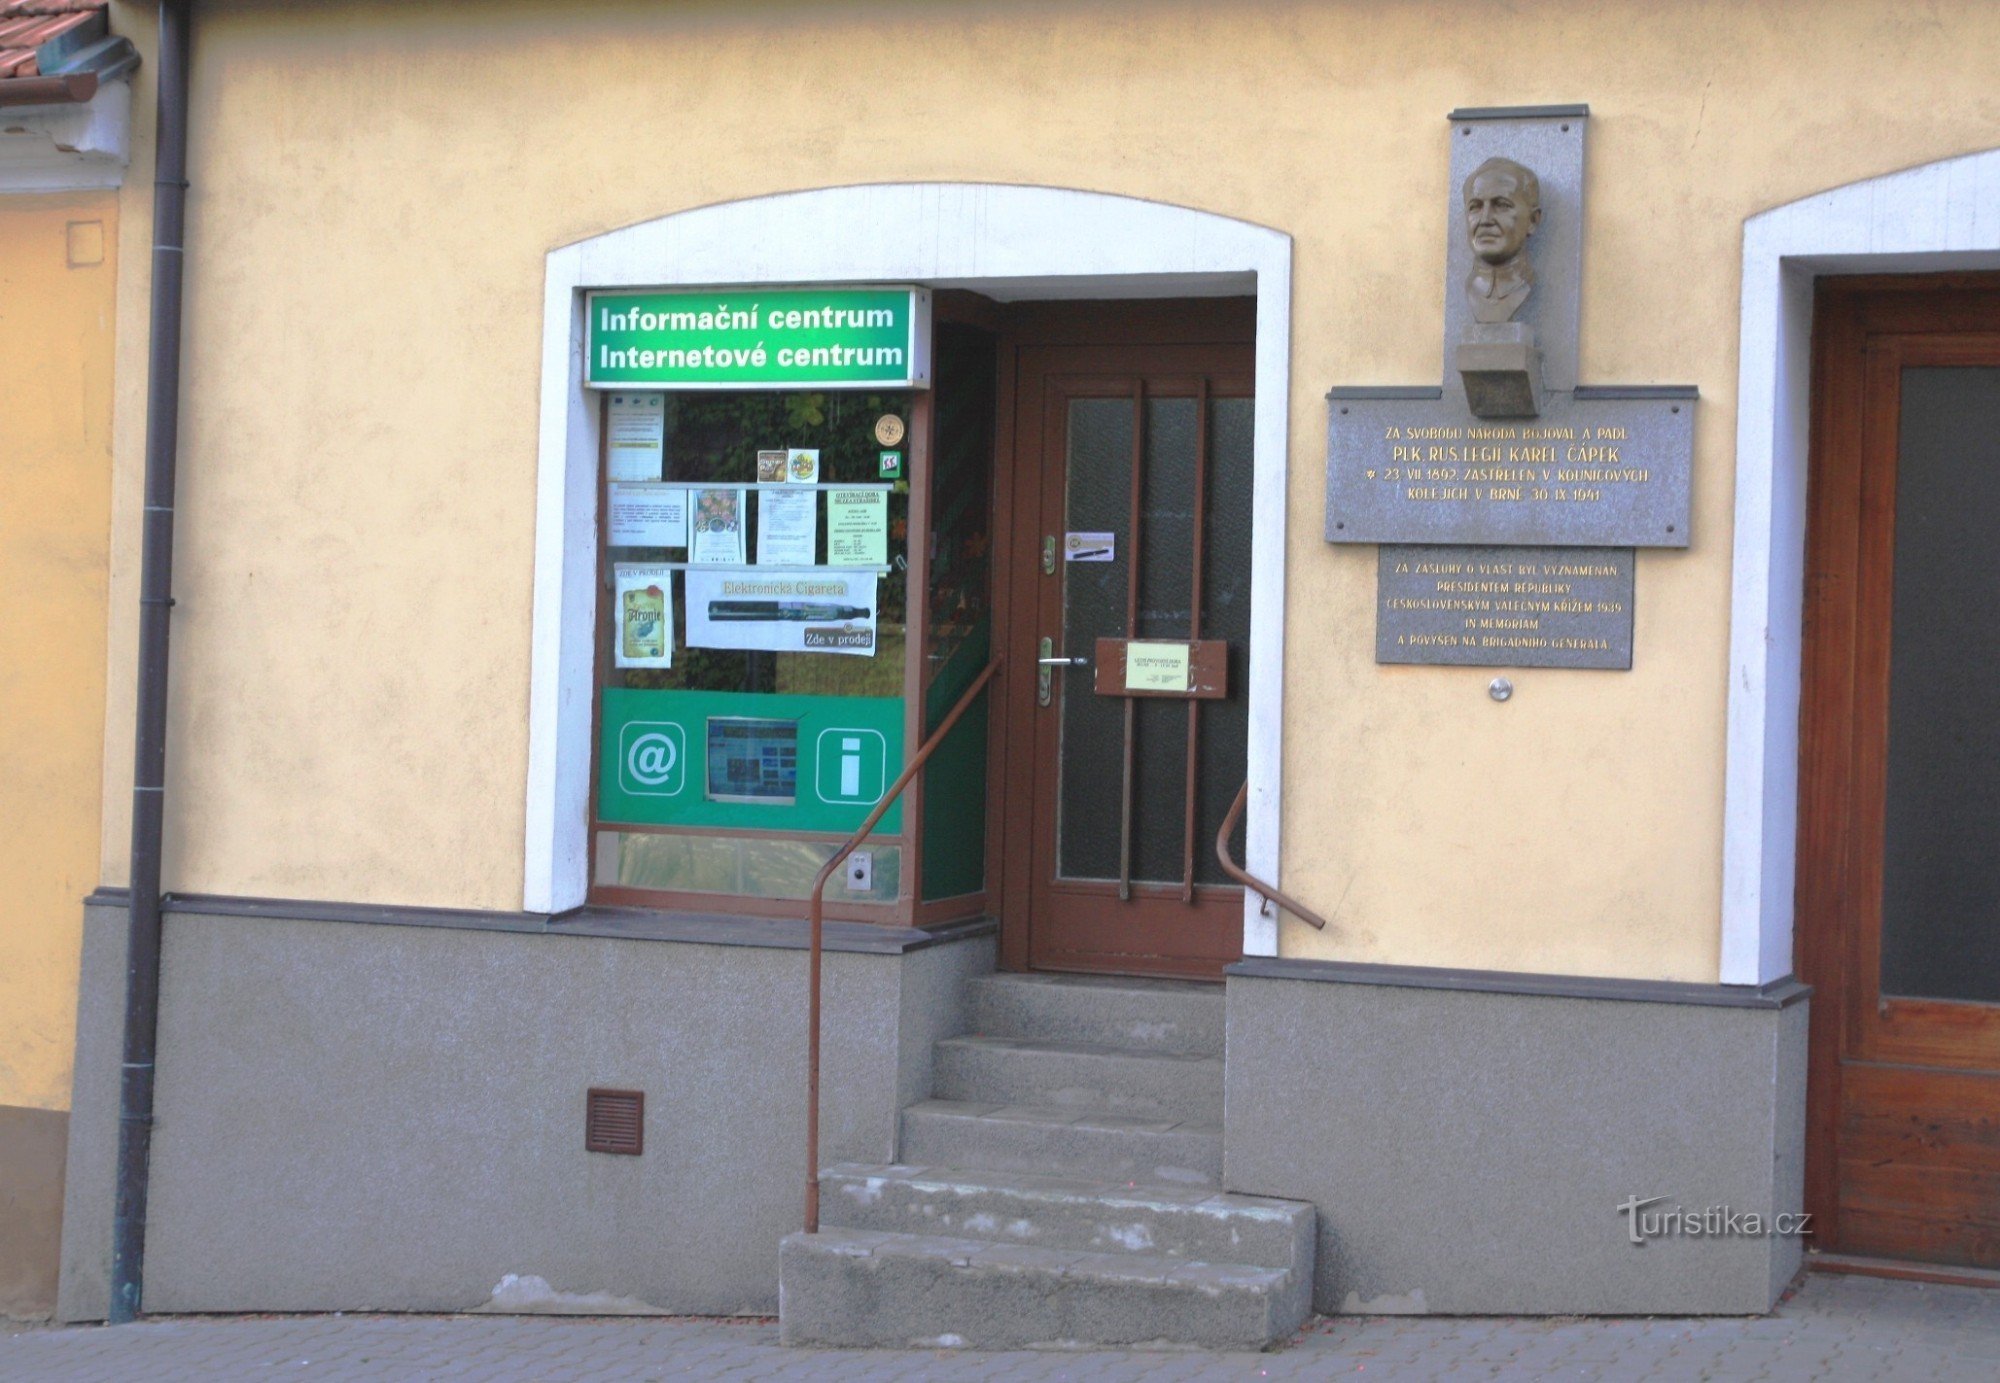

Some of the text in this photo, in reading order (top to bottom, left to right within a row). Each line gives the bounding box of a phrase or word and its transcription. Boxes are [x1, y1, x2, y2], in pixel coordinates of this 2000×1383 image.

[601, 304, 893, 331] Informační centrum
[601, 341, 902, 368] Internetové centrum
[1385, 427, 1400, 439] ZA
[1406, 427, 1461, 440] SVOBODU
[1522, 427, 1576, 440] BOJOVAL
[1582, 427, 1591, 440] A
[1597, 427, 1628, 440] PADL
[1509, 446, 1557, 463] KAREL
[1567, 442, 1620, 463] ČÁPEK
[1543, 469, 1551, 481] V
[1475, 487, 1483, 500] V
[1480, 564, 1513, 575] VLAST
[1519, 564, 1538, 575] BYL
[796, 582, 844, 597] Cigareta
[1437, 581, 1572, 594] PRESIDENTEM REPUBLIKY
[1598, 602, 1622, 613] 1939
[1465, 618, 1539, 630] IN MEMORIAM
[806, 633, 825, 645] Zde
[829, 636, 834, 645] v
[1397, 635, 1405, 646] A
